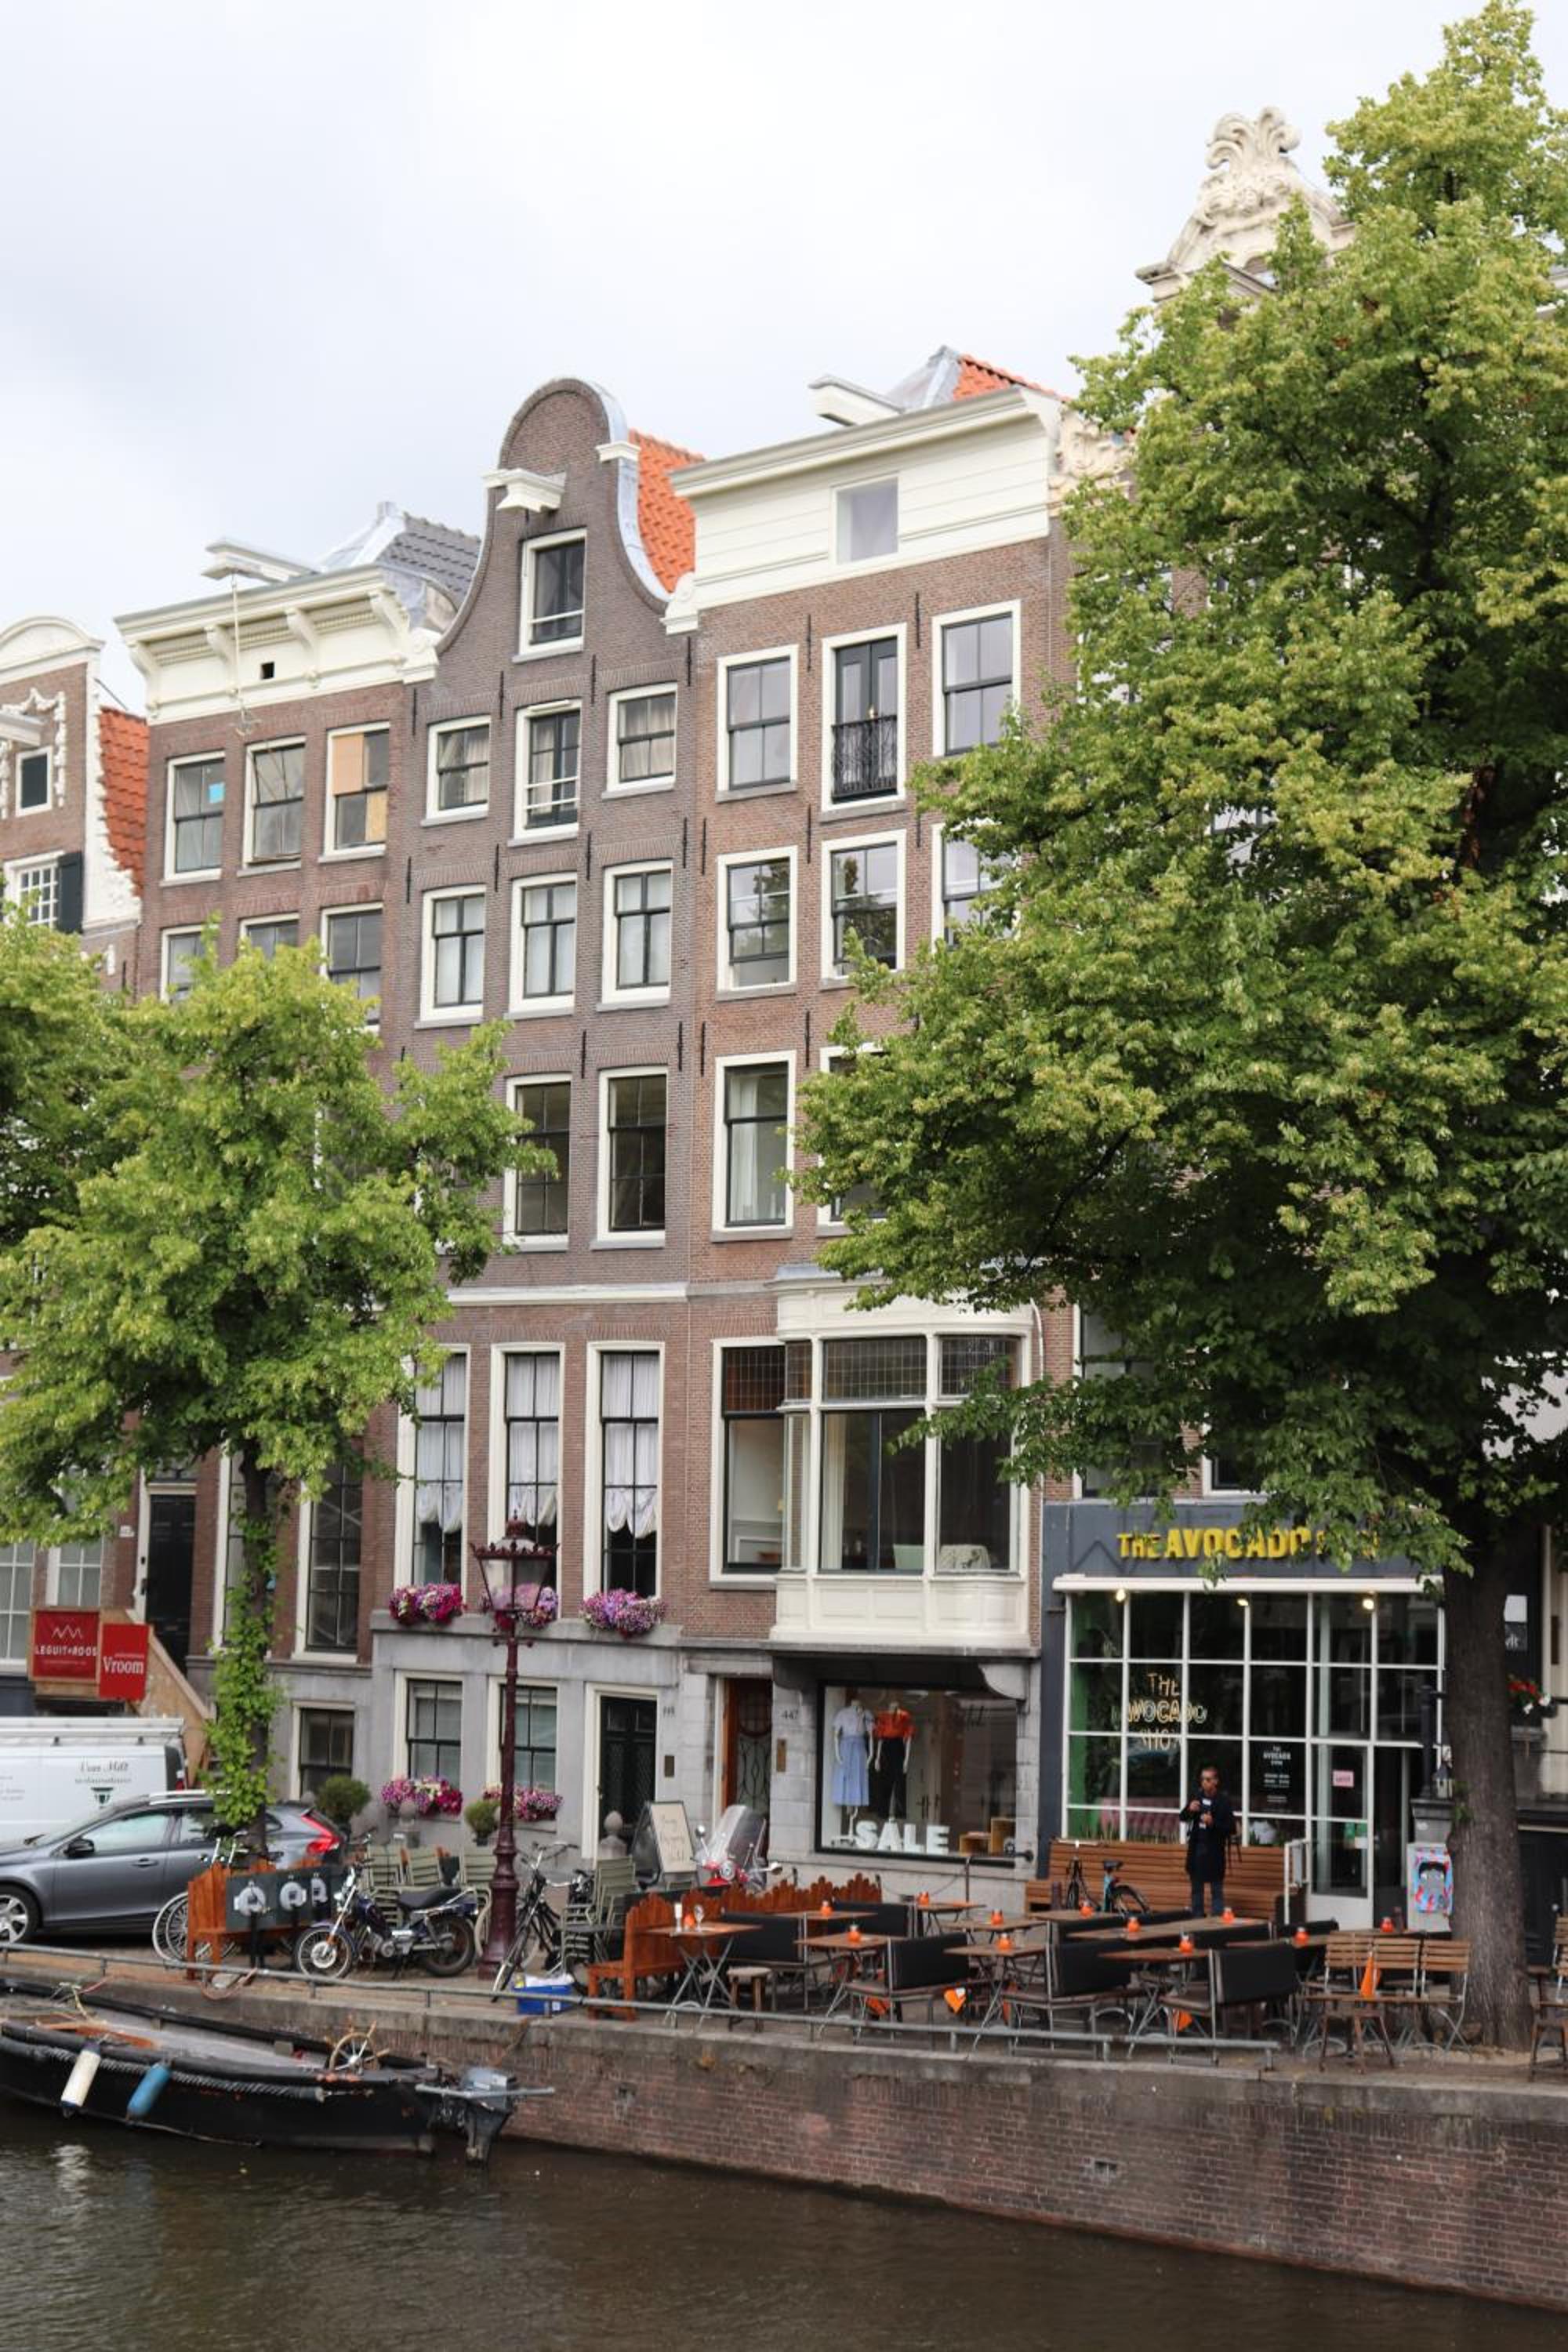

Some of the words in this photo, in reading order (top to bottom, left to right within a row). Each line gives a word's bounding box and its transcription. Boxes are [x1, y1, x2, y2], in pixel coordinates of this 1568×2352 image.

[1117, 1534, 1161, 1558] THE
[1164, 1527, 1311, 1559] AVOCADO
[103, 1657, 144, 1674] Vroom
[1147, 1672, 1181, 1697] THE
[855, 1820, 950, 1855] SALE
